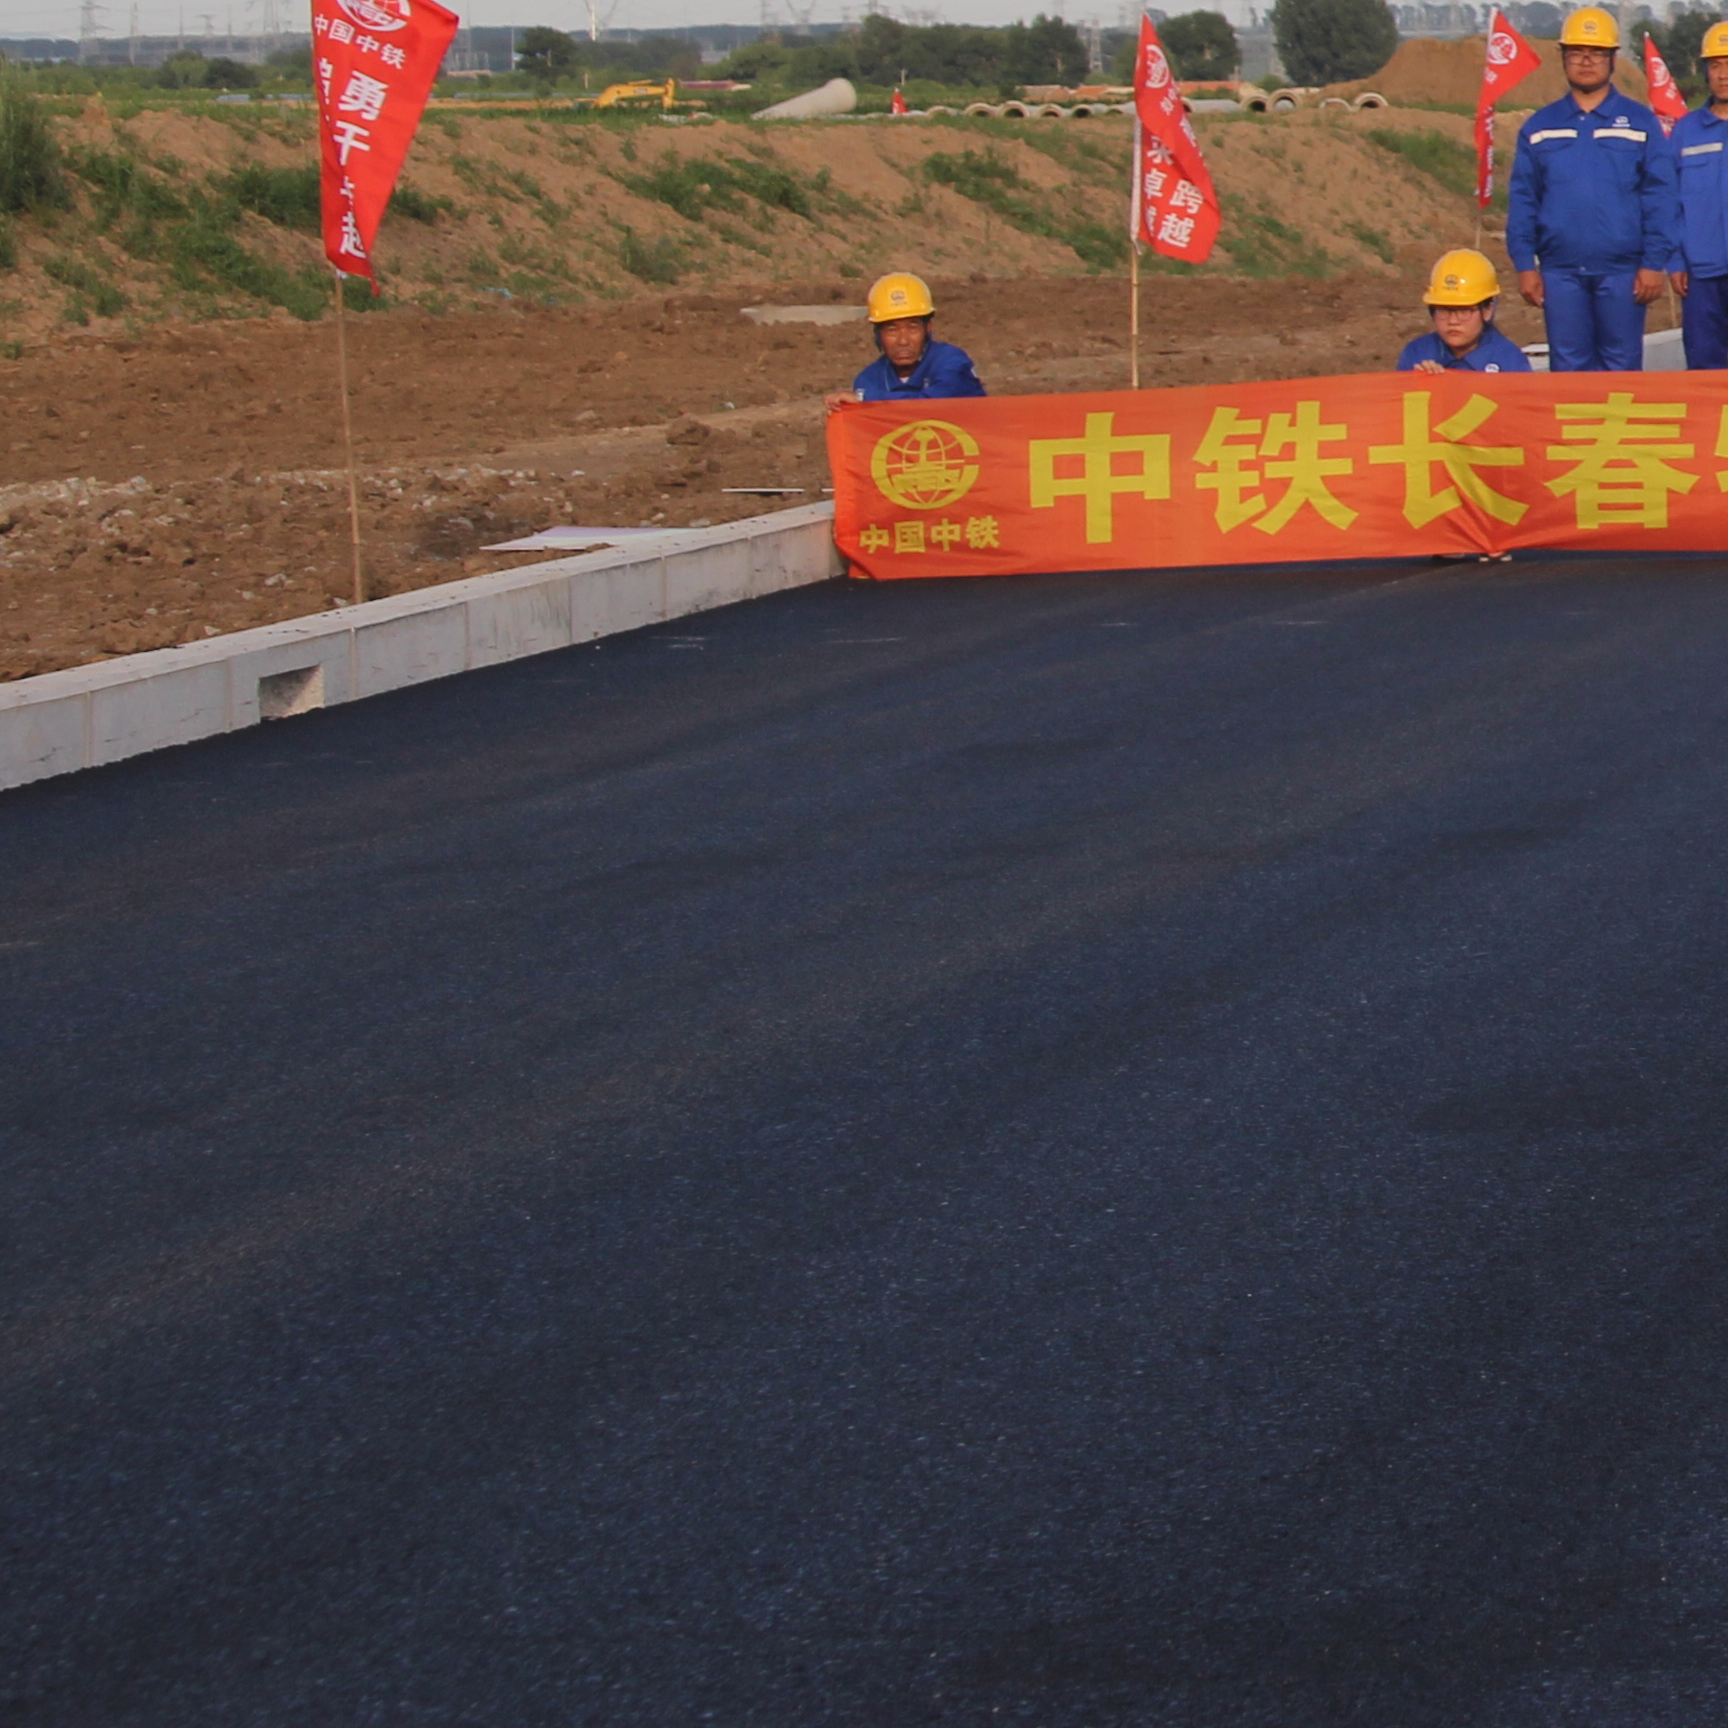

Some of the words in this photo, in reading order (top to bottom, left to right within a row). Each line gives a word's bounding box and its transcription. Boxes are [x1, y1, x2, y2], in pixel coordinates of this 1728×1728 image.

[314, 13, 406, 70] 中国中铁
[859, 515, 1000, 554] 中国中铁
